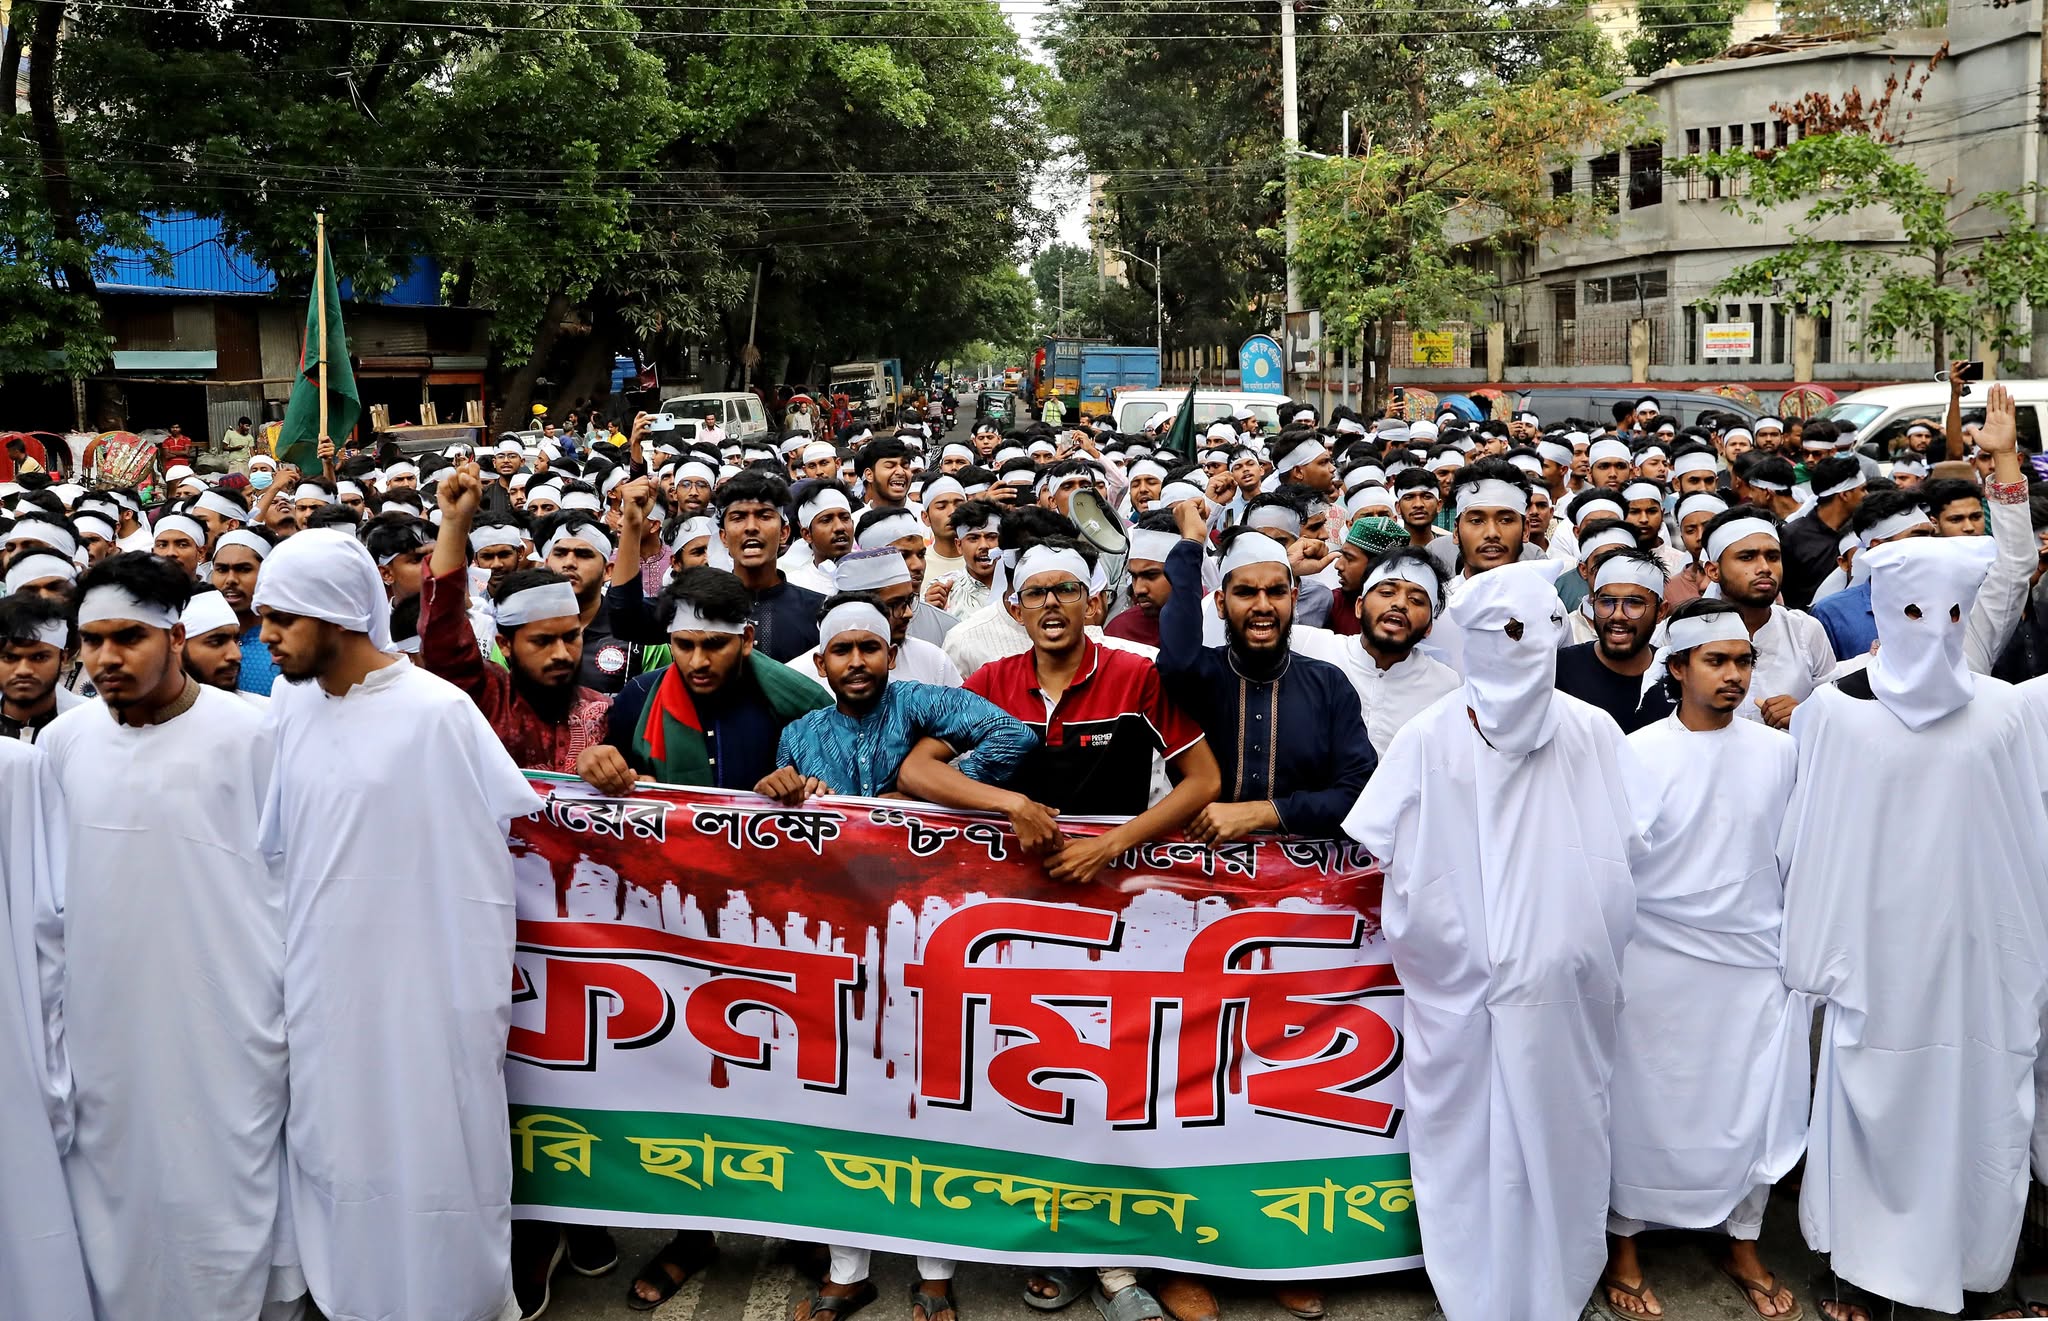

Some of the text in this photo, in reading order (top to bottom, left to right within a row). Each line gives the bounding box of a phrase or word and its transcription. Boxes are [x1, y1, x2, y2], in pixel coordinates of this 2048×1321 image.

[529, 792, 677, 843] ায়ের
[686, 803, 848, 855] লক্ষে
[506, 898, 1405, 1139] ফন মিছি
[511, 1113, 1414, 1244] রি ছাত্র আন্দোলন, বাংল
